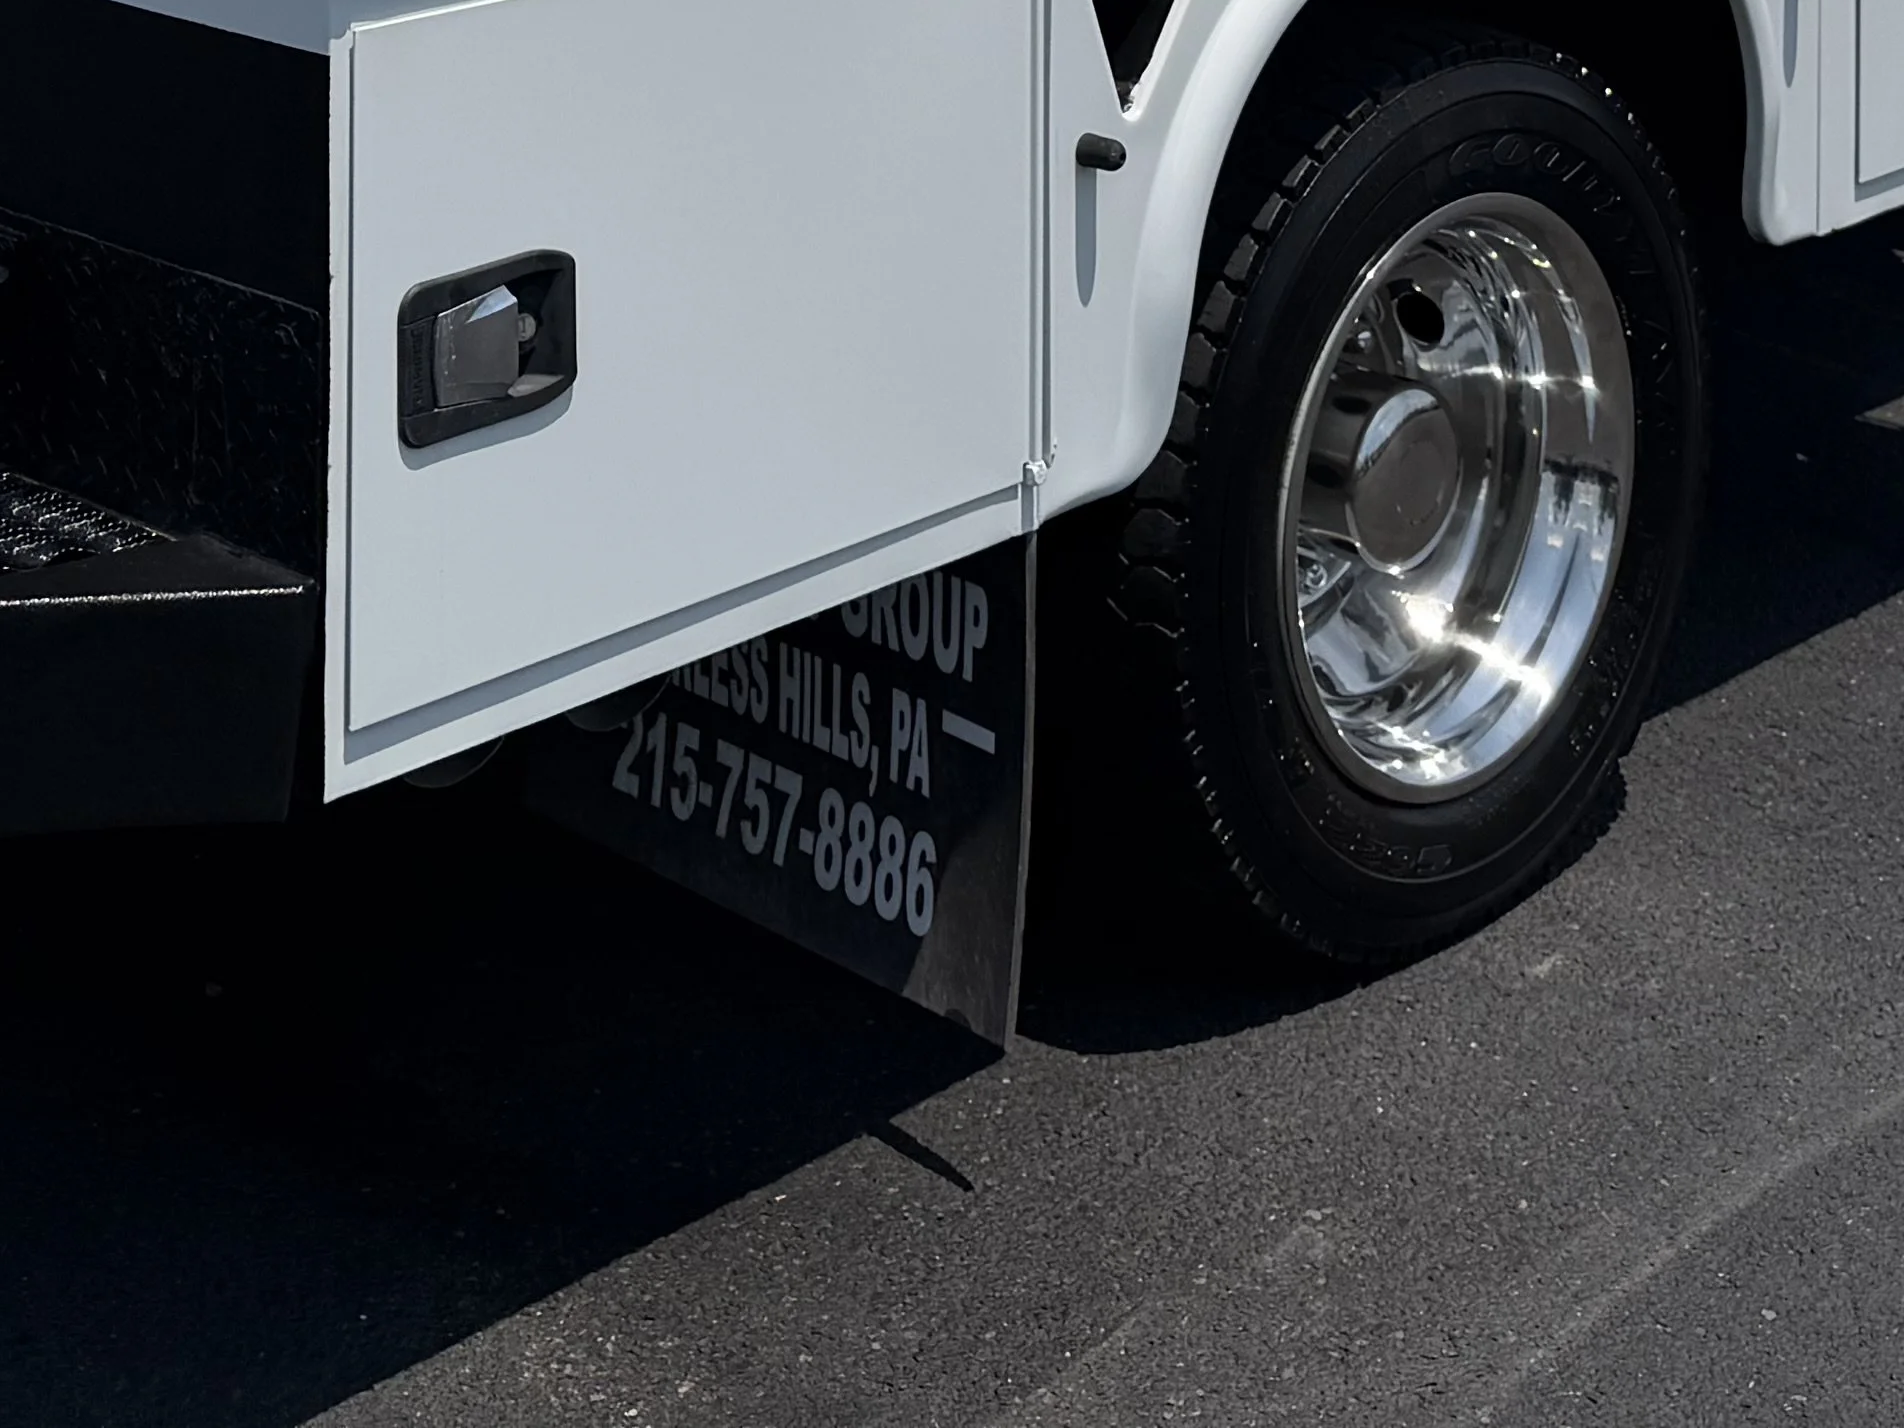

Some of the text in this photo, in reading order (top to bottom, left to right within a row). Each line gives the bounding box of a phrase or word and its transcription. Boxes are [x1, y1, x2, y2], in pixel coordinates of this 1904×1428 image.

[778, 640, 880, 797] HILLS,
[889, 687, 931, 799] PA
[611, 709, 938, 938] 215-757-8886
